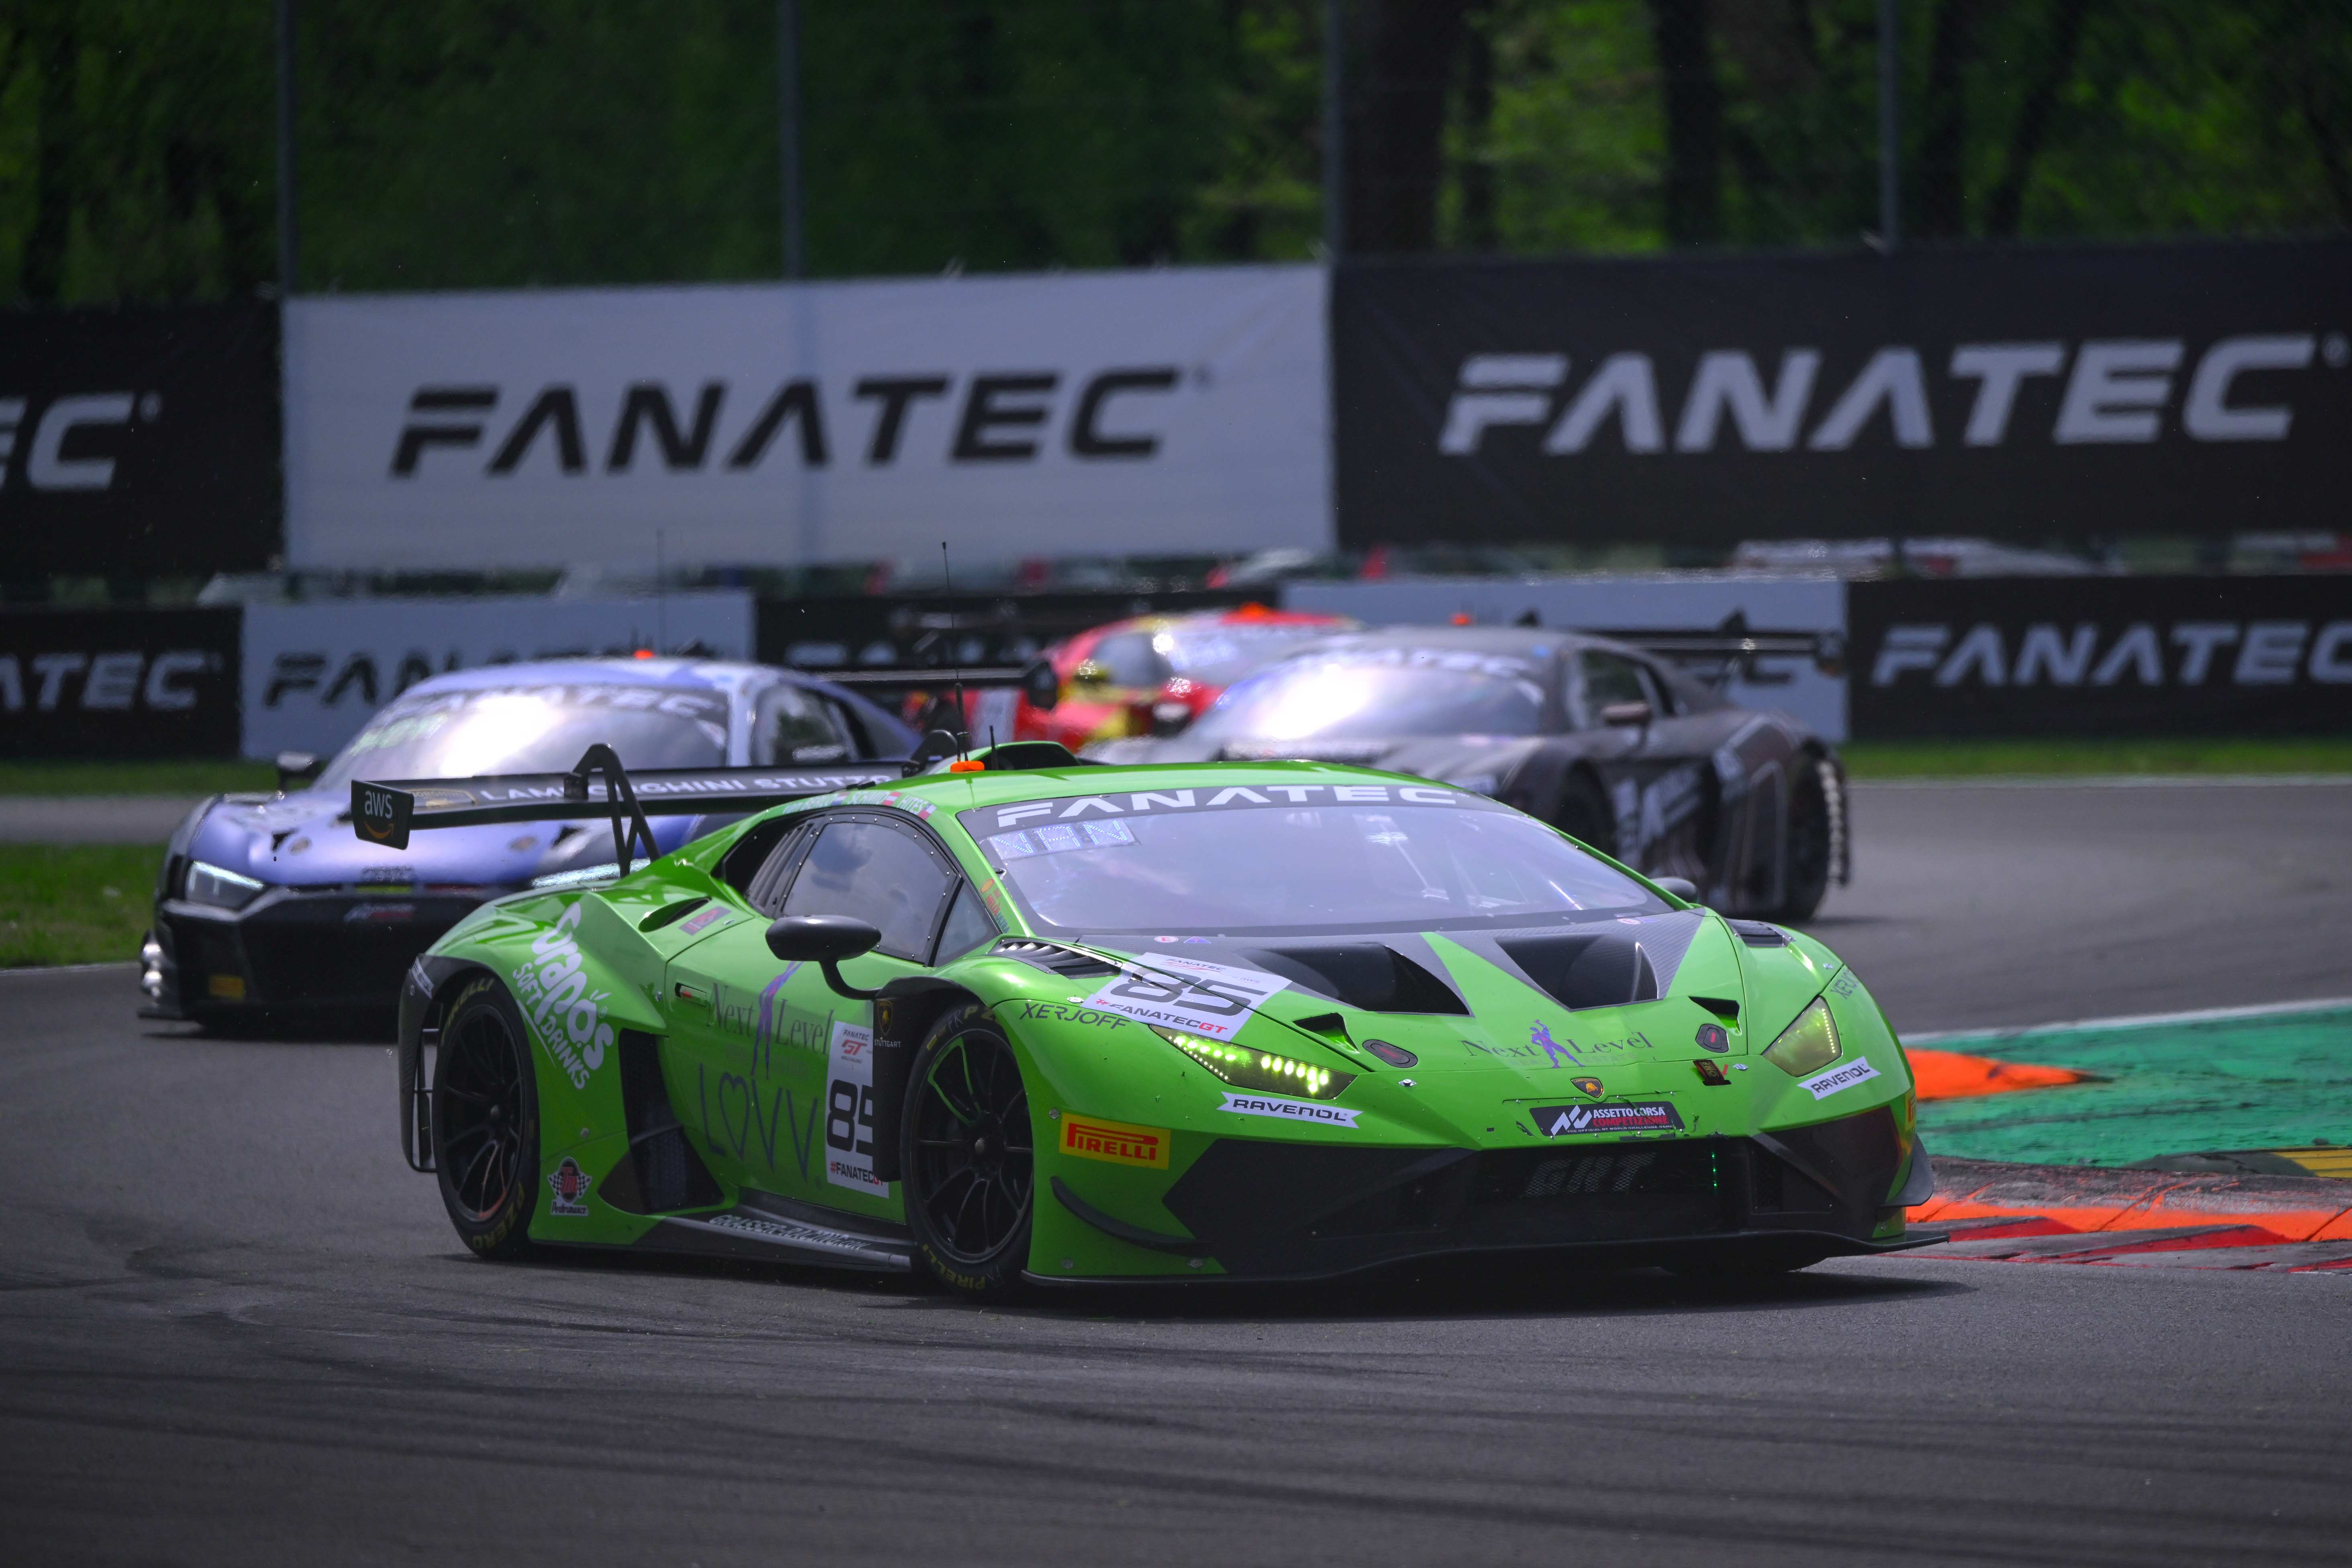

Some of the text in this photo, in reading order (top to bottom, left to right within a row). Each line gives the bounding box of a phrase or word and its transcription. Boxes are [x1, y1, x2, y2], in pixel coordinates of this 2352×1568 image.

[1438, 335, 2317, 455] FANATEC
[389, 367, 1192, 479] FANATEC
[365, 790, 392, 819] aws
[997, 785, 1456, 827] FANATEC
[994, 820, 1128, 853] VAN
[1166, 958, 1226, 971] FANATEC
[1110, 968, 1268, 1016] 85
[513, 962, 590, 1090] SOFT DRINKS
[706, 983, 834, 1055] Next Level
[1019, 1003, 1131, 1029] XERJOFF
[1095, 998, 1228, 1034] #FANATECGT
[843, 1030, 870, 1041] FANATEC
[874, 1039, 901, 1048] STUTTGART
[1459, 1031, 1655, 1058] Next Level
[1583, 1052, 1639, 1064] ESTATE
[1810, 1065, 1871, 1093] RAVENOL
[1233, 1099, 1348, 1122] RAVENOL
[1593, 1107, 1666, 1118] ASSETTO CORSA
[1593, 1116, 1669, 1127] COMPETIZIONE
[1066, 1123, 1159, 1161] PIRELLI
